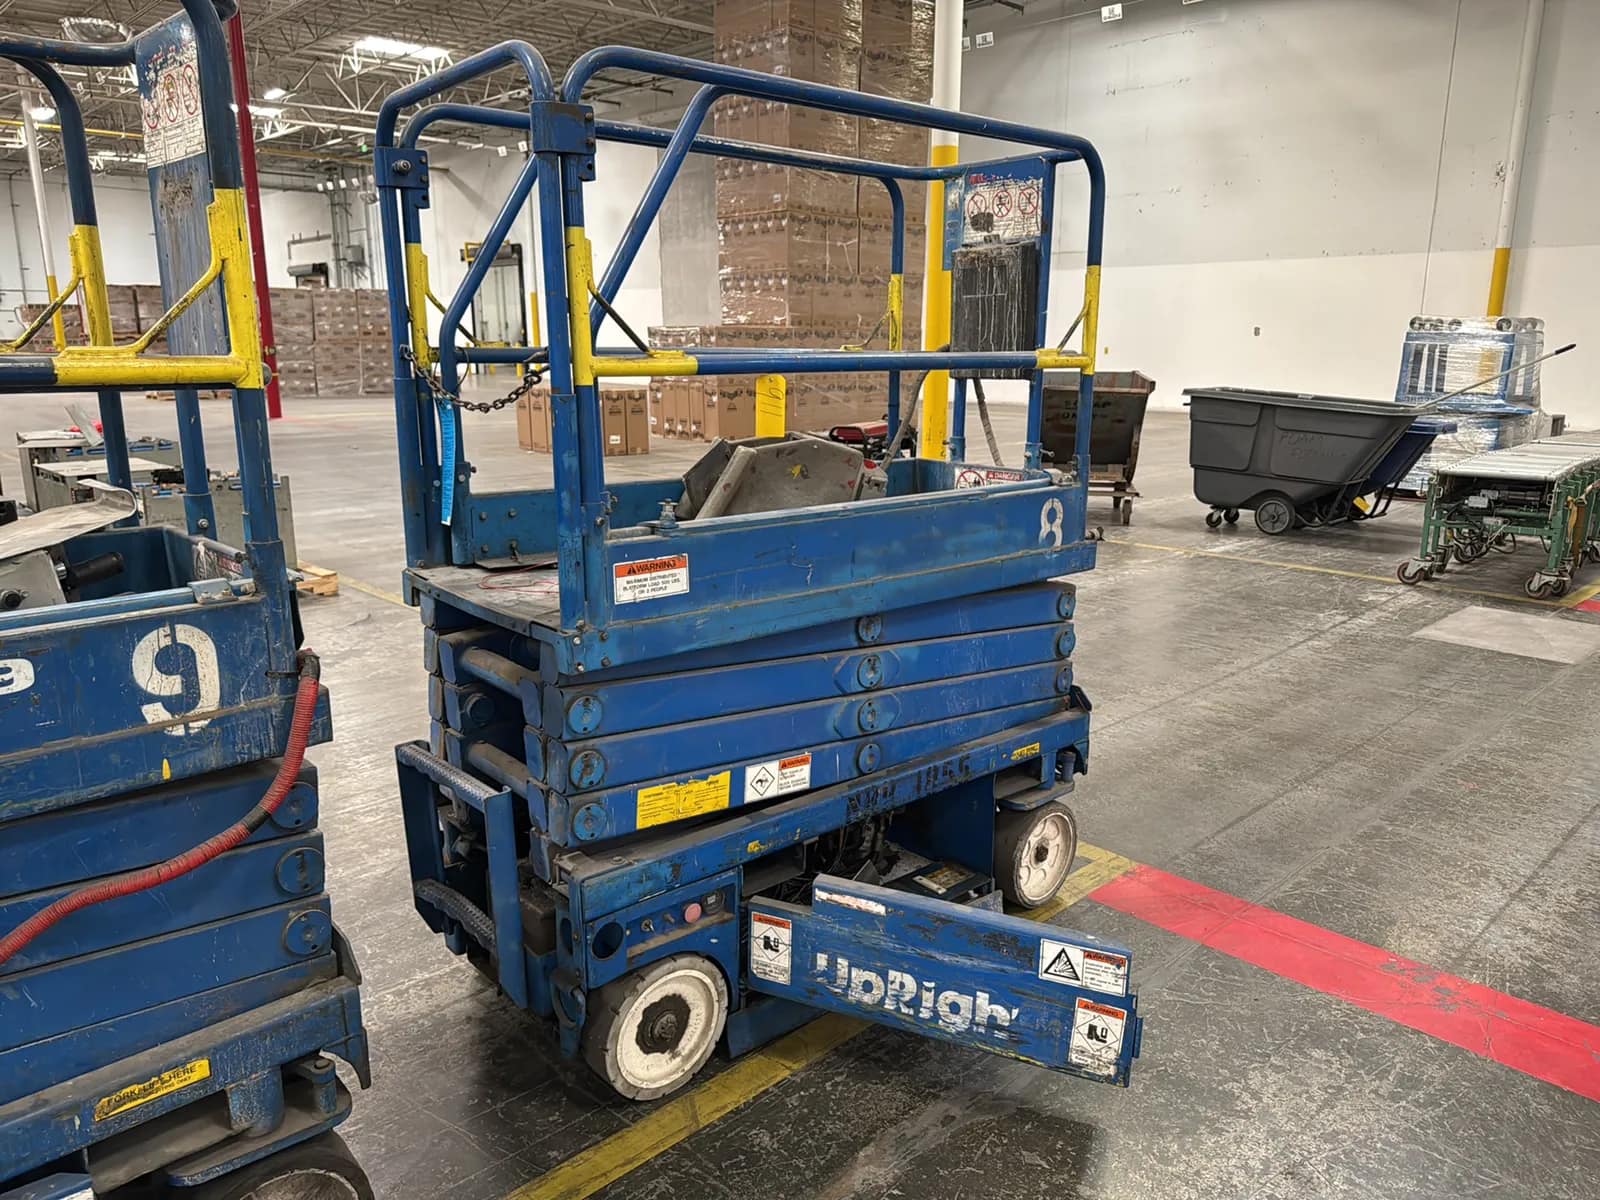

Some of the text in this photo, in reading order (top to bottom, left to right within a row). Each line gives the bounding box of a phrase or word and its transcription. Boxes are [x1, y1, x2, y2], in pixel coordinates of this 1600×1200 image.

[1039, 498, 1063, 558] 8
[635, 559, 677, 573] WARNING
[132, 623, 221, 736] 9
